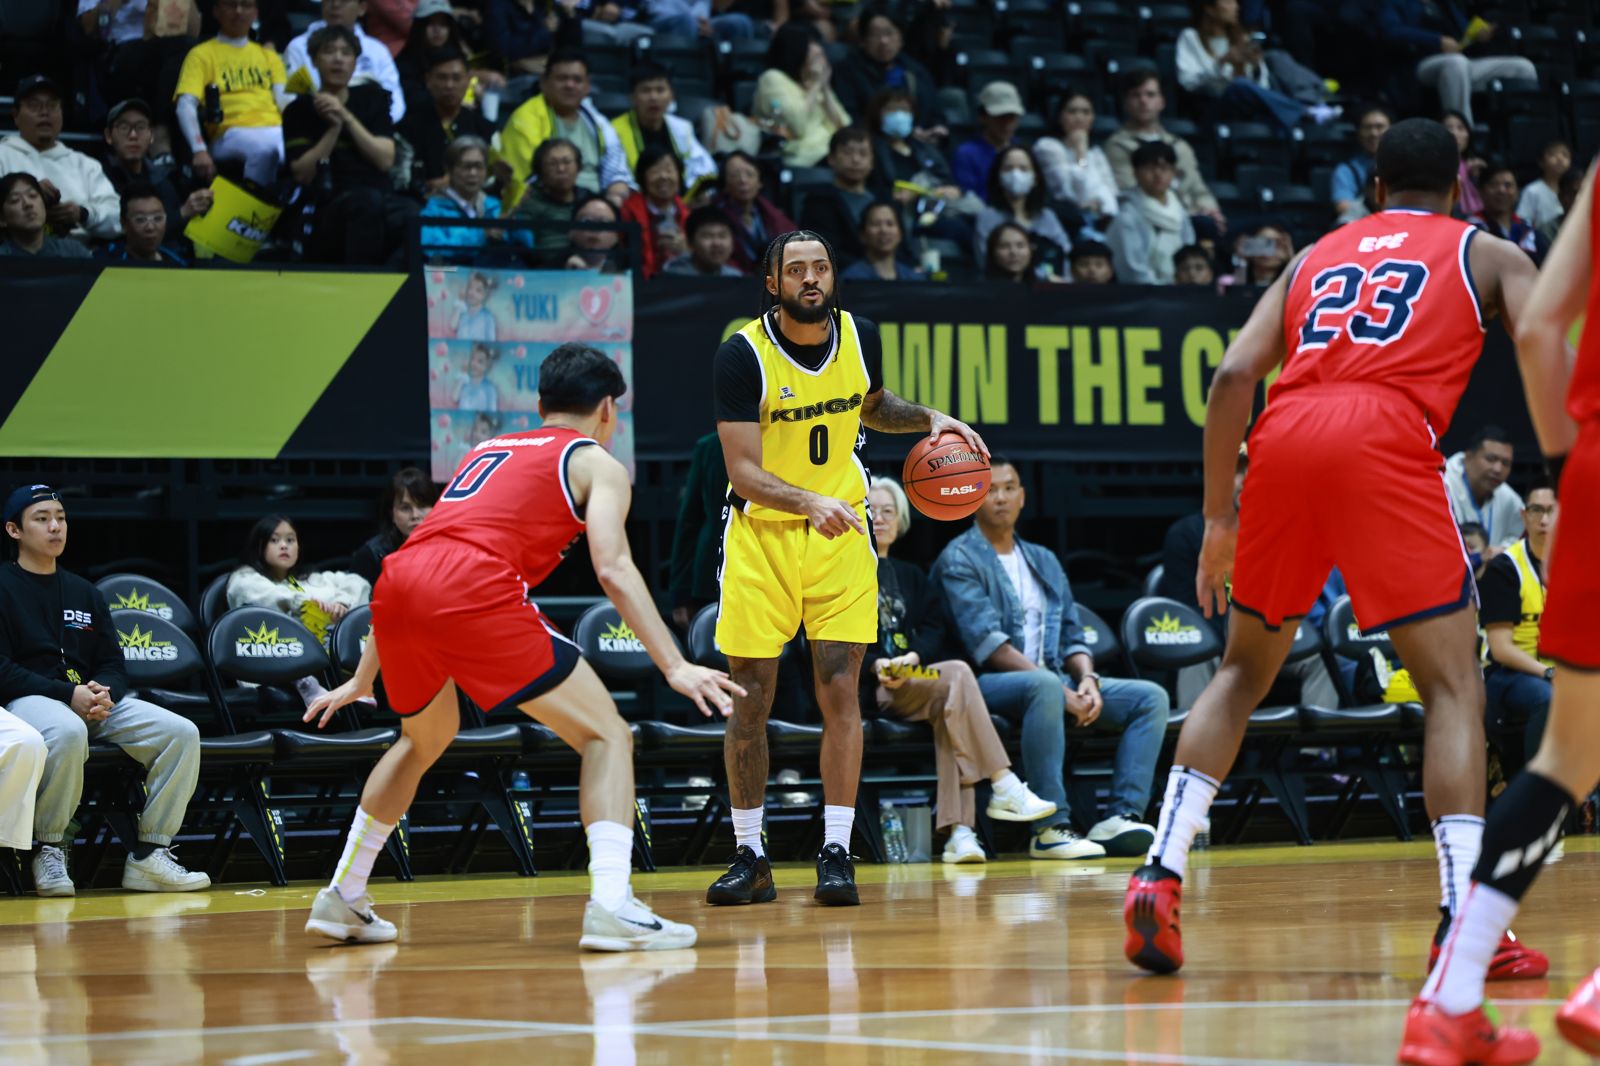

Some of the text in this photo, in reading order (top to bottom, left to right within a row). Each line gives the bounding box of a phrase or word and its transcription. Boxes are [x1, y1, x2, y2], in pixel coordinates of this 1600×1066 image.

[227, 217, 266, 240] KIN
[1357, 231, 1409, 253] EFE
[512, 294, 559, 321] YUKI
[1296, 257, 1430, 354] 23
[513, 364, 541, 392] YU
[1025, 326, 1164, 426] THE
[770, 393, 862, 424] KINGS
[809, 424, 829, 466] 0
[927, 451, 986, 473] SPALDING
[439, 450, 513, 502] 0
[940, 484, 977, 496] EASL
[235, 641, 304, 657] KINGS
[598, 636, 648, 652] KING
[1144, 630, 1202, 645] KINGS
[120, 645, 179, 661] INGS
